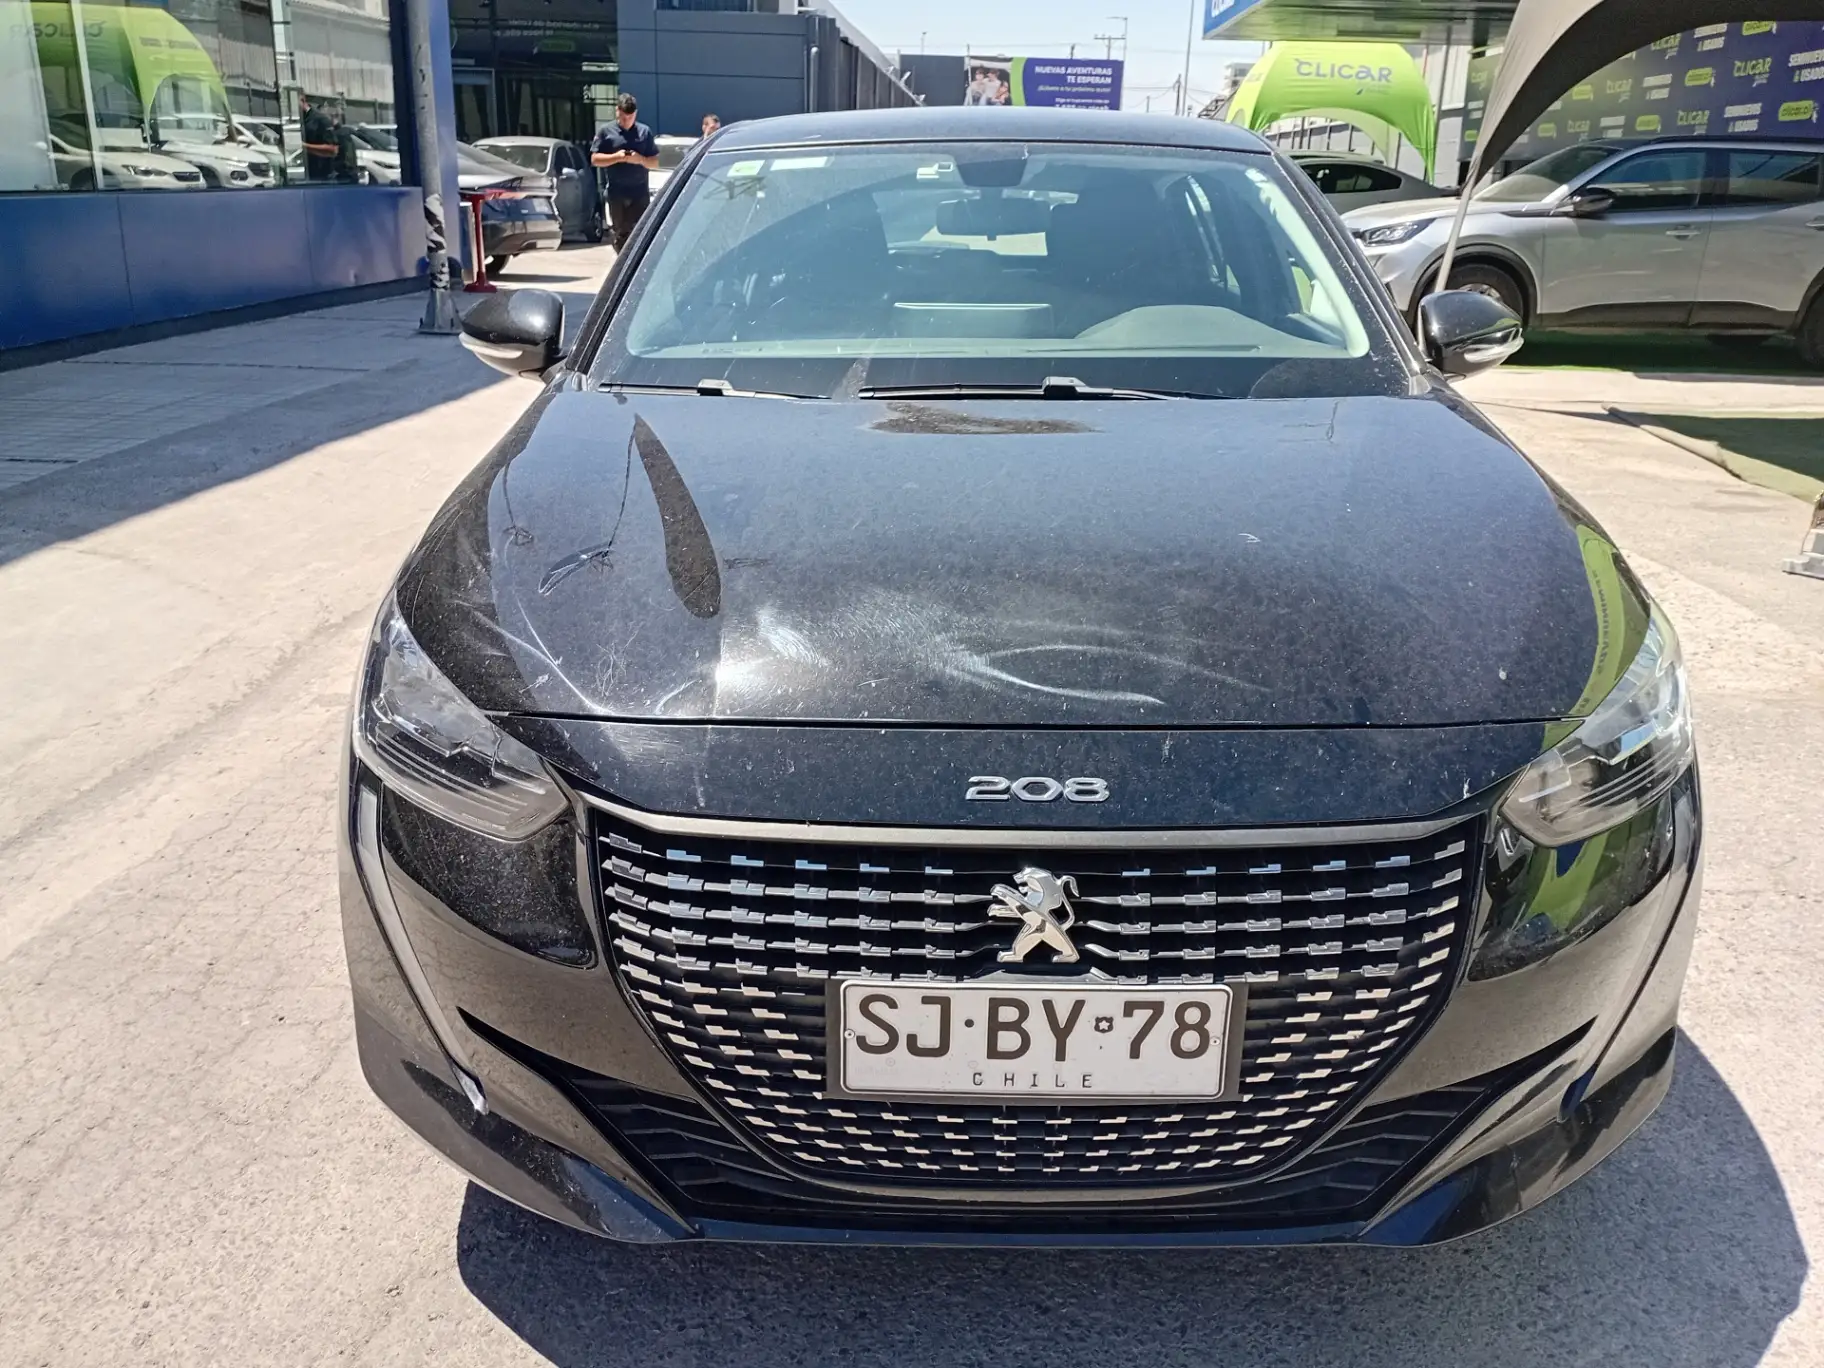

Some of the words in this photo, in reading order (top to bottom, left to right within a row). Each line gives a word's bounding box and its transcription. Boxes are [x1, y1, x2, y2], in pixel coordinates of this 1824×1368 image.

[1035, 66, 1065, 74] NUEVAS
[1066, 67, 1112, 75] AVENTURAS
[1077, 76, 1112, 84] ESPERAN
[965, 775, 1110, 802] 208
[972, 1072, 1093, 1089] CHILE
